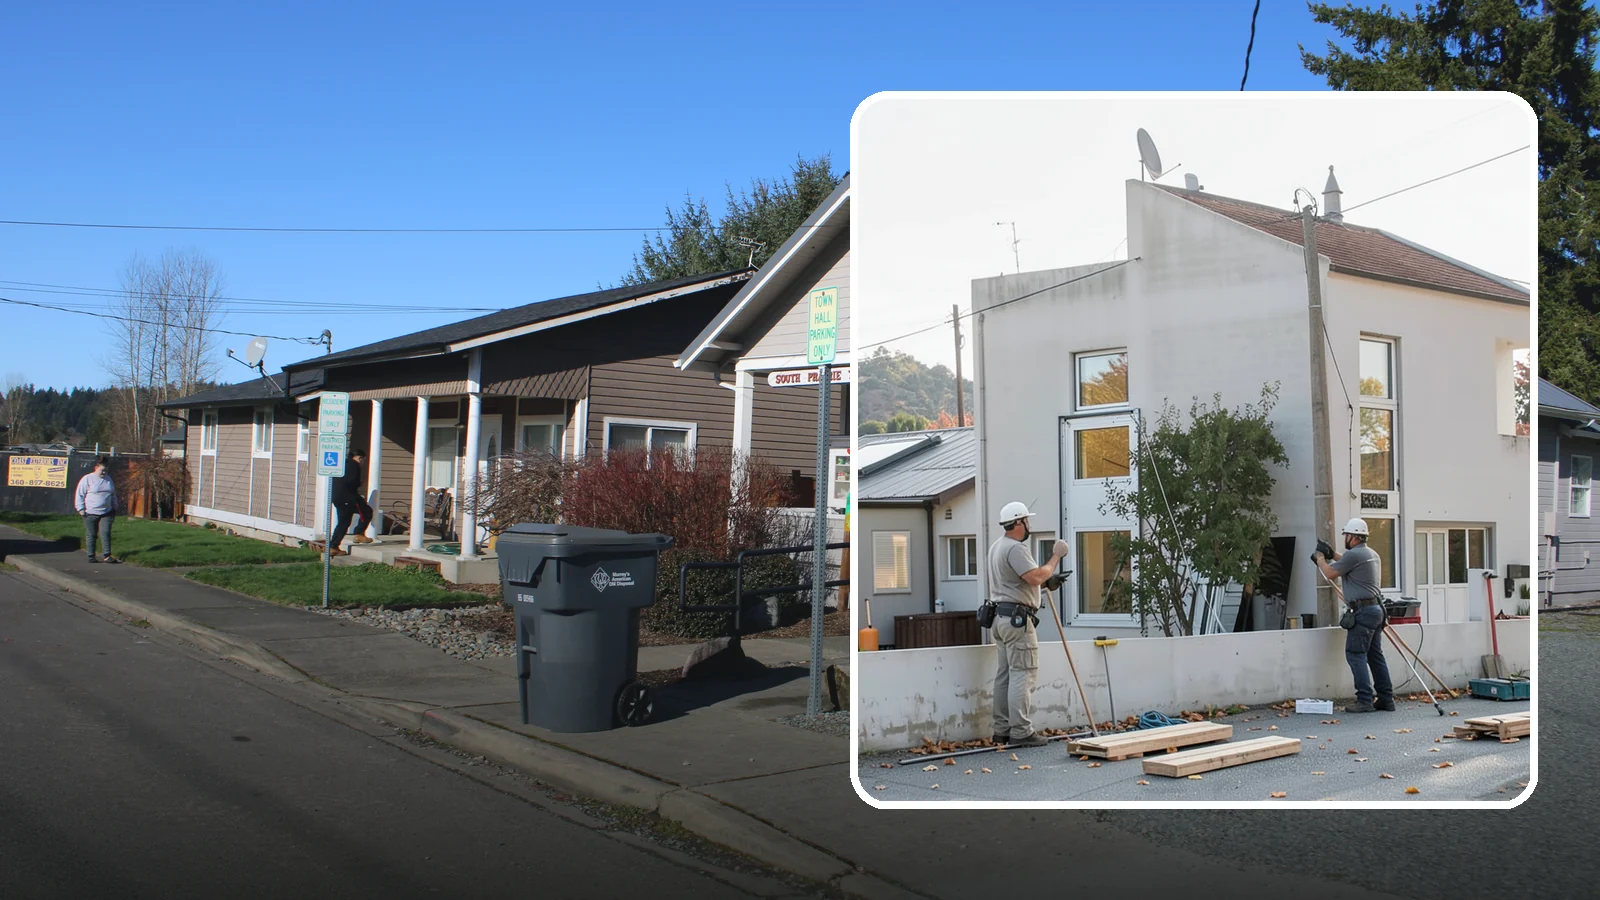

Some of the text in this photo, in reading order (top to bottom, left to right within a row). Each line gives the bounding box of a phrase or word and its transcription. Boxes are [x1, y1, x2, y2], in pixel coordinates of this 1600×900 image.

[815, 295, 833, 308] TOWN
[814, 311, 832, 324] HALL
[810, 327, 836, 340] PARKING
[813, 344, 831, 357] ONLY
[775, 373, 801, 384] SOUTH
[807, 371, 842, 382] PRIE
[325, 420, 341, 428] ONLY
